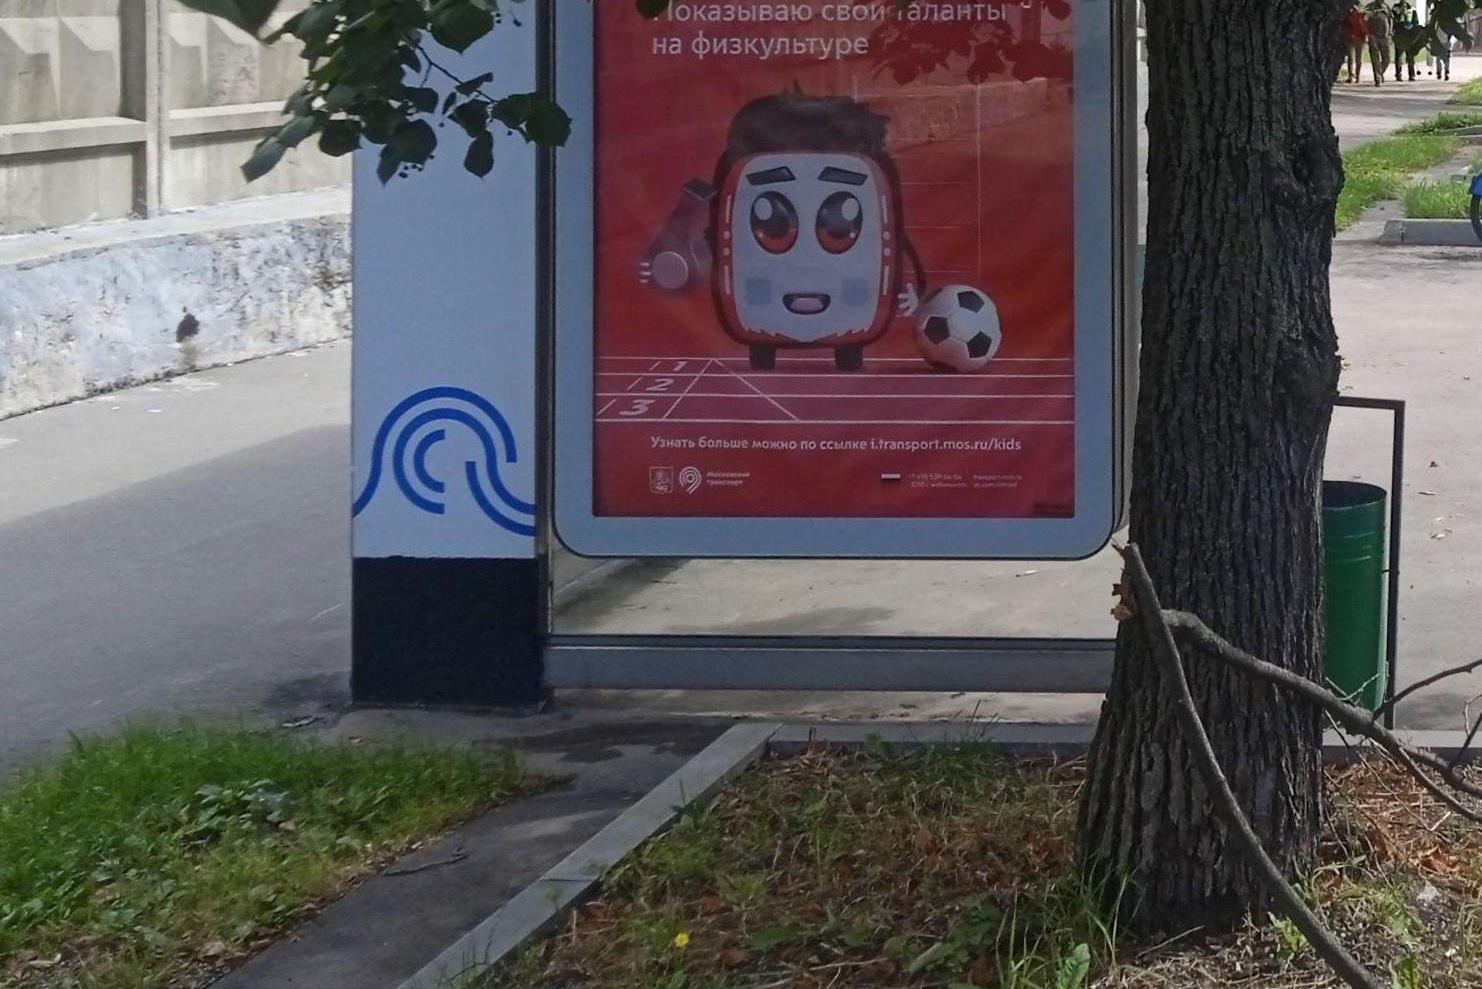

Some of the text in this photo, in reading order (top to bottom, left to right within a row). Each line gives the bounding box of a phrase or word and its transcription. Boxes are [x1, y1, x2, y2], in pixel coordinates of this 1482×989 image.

[896, 4, 1006, 22] аланты
[653, 30, 870, 60] на физкультуре
[673, 360, 688, 372] 1
[645, 377, 675, 392] 2
[619, 399, 656, 416] 3
[651, 436, 695, 449] Узнать
[699, 435, 749, 449] больше
[752, 439, 797, 450] можно
[800, 440, 817, 450] по
[820, 439, 868, 450] ссылке
